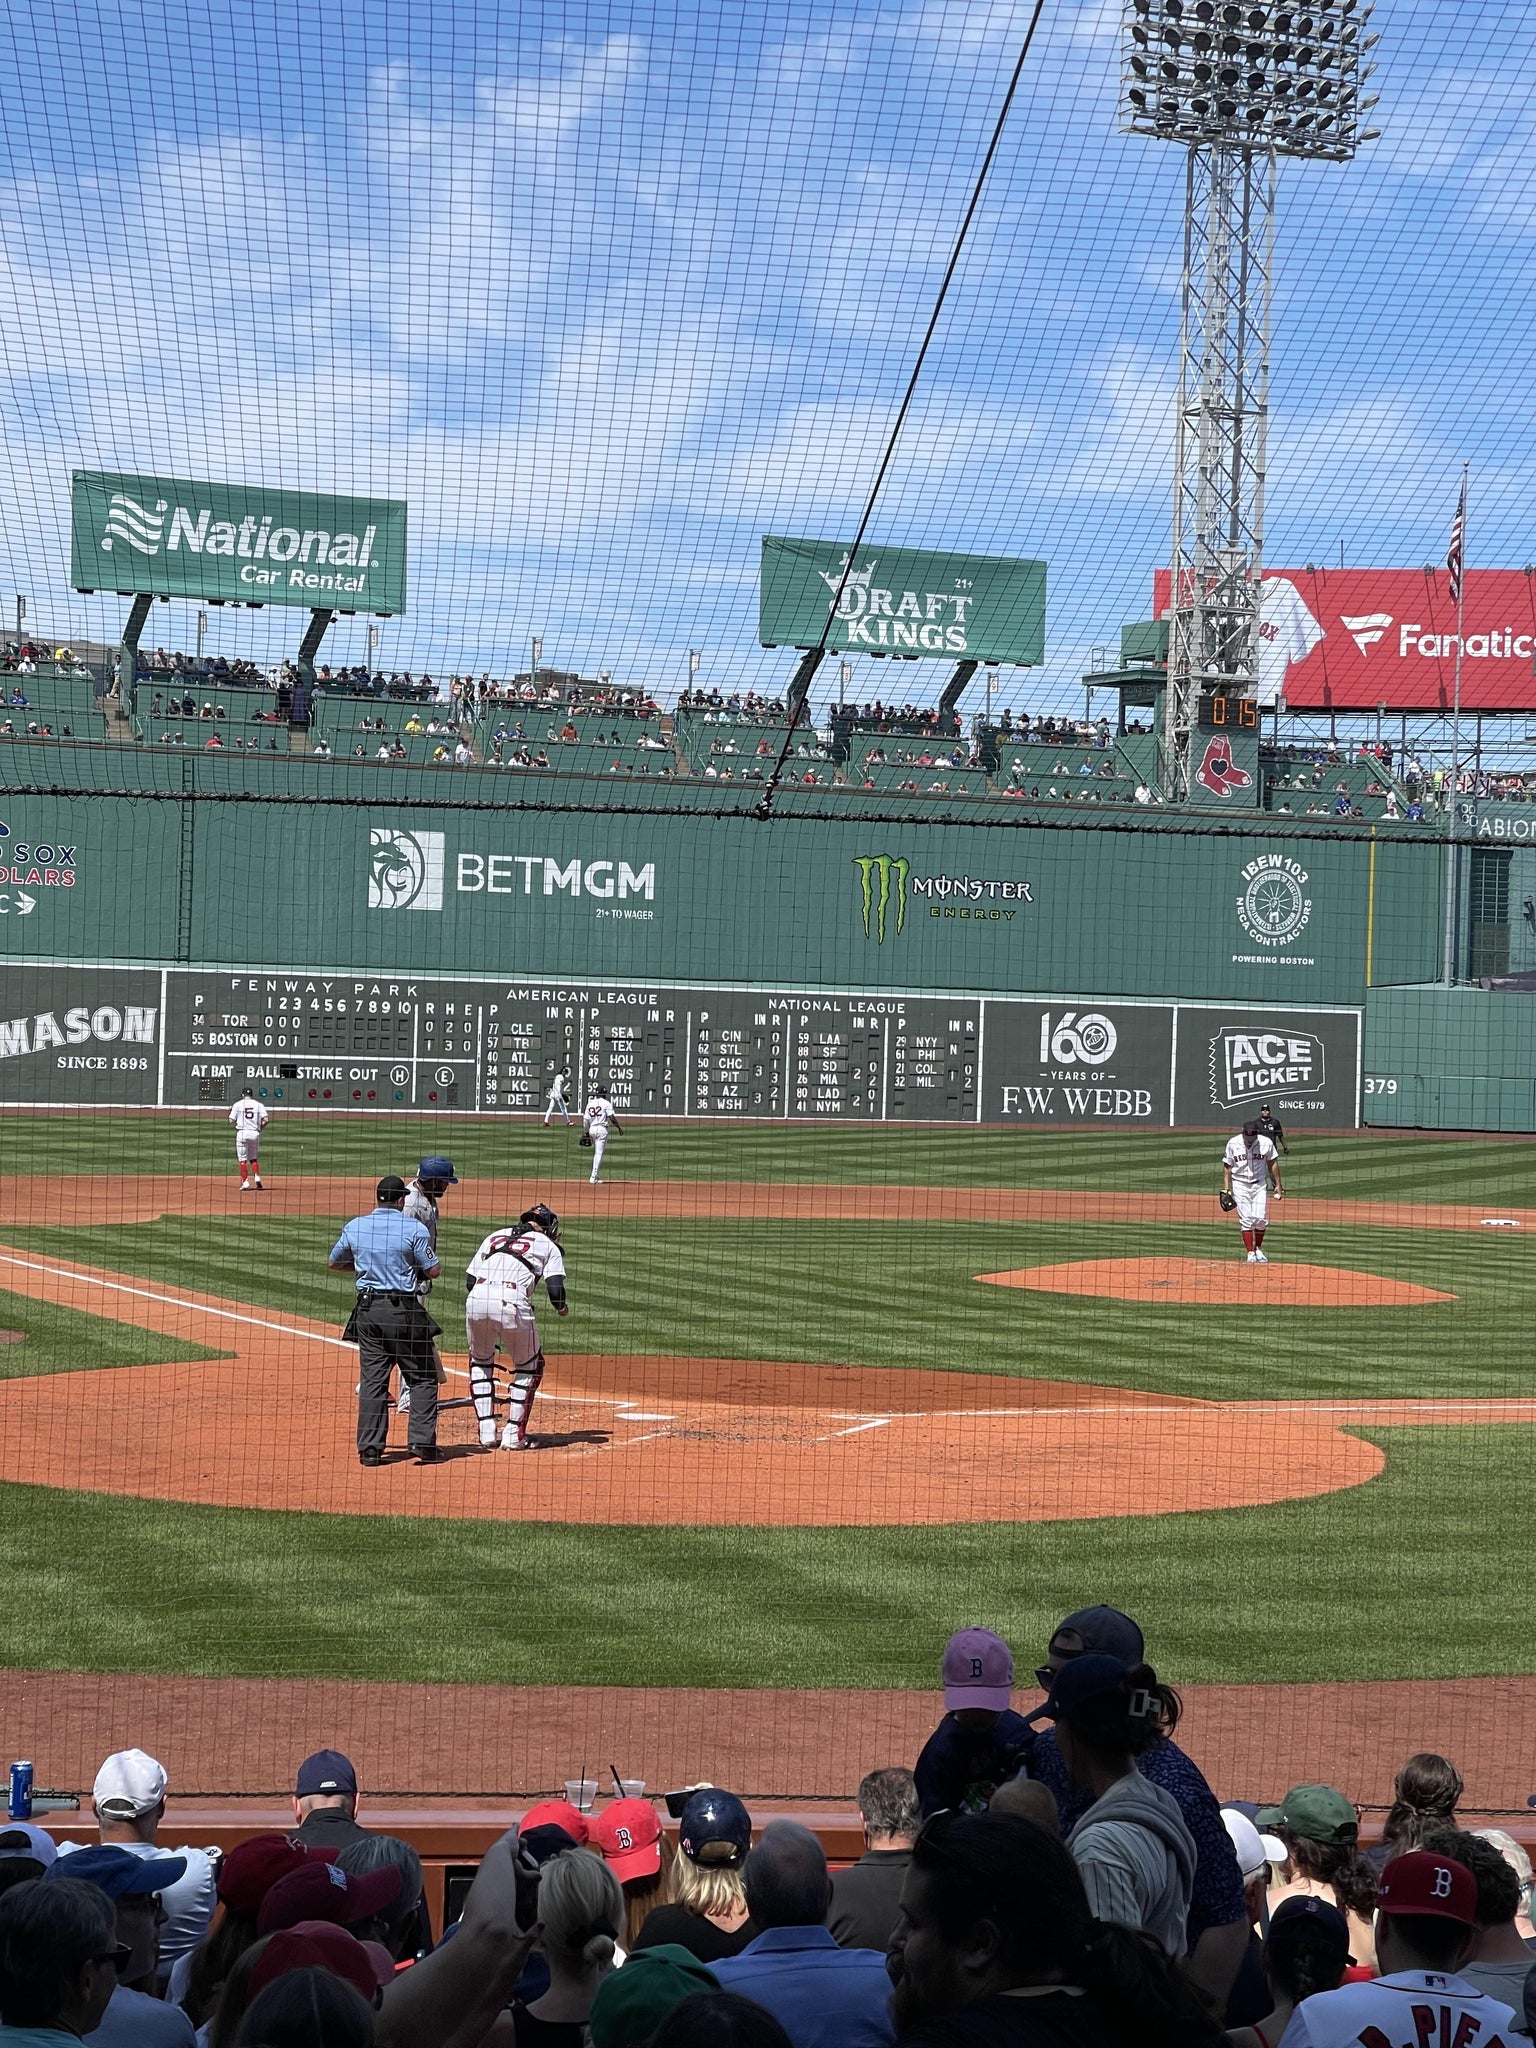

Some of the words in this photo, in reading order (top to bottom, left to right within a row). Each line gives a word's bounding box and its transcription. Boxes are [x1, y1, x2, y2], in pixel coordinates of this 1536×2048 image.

[167, 507, 376, 567] National
[241, 566, 281, 585] Car
[289, 569, 365, 592] Rental
[955, 578, 973, 589] 21+
[829, 584, 972, 622] DRAFT
[847, 615, 968, 651] KINGS
[14, 844, 77, 866] SOX
[457, 853, 655, 900] BETMGM
[912, 874, 1034, 902] MONSTER
[596, 909, 609, 918] 21+
[612, 909, 622, 919] TO
[624, 910, 653, 920] WAGER
[930, 907, 1016, 920] ENERGY
[1236, 897, 1250, 931] NECA
[1249, 899, 1312, 947] CONTRACTORS
[1232, 955, 1277, 964] POWERING
[1280, 956, 1314, 965] BOSTON
[232, 979, 333, 993] FENWAY
[354, 984, 417, 997] PARK
[506, 989, 589, 1003] AMERICAN
[598, 992, 657, 1005] LEAGUE
[195, 995, 203, 1007] P
[279, 997, 287, 1009] 2
[293, 997, 301, 1010] 3
[310, 998, 319, 1010] 4
[324, 999, 333, 1011] 5
[337, 999, 346, 1012] 6
[356, 1000, 363, 1012] 7
[369, 1001, 377, 1013] 8
[381, 1001, 390, 1013] 9
[399, 1002, 411, 1014] 10
[426, 1003, 434, 1014] R
[446, 1003, 454, 1015] H
[465, 1004, 472, 1015] E
[769, 999, 841, 1012] NATIONAL
[849, 1001, 905, 1014] LEAGUE
[490, 1005, 498, 1016] P
[547, 1007, 558, 1018] IN
[565, 1007, 573, 1018] R
[591, 1008, 599, 1019] P
[647, 1010, 659, 1021] IN
[666, 1010, 674, 1021] R
[192, 1014, 204, 1026] 34
[222, 1015, 248, 1027] TOR
[265, 1016, 273, 1027] 0
[279, 1017, 286, 1028] 0
[292, 1017, 300, 1028] 0
[426, 1021, 433, 1032] 0
[446, 1022, 453, 1033] 2
[464, 1022, 471, 1033] 0
[701, 1012, 709, 1023] P
[755, 1014, 766, 1025] IN
[773, 1015, 780, 1025] R
[801, 1015, 808, 1026] P
[853, 1017, 864, 1028] IN
[871, 1018, 878, 1029] R
[489, 1023, 499, 1034] 77
[511, 1024, 533, 1035] CLE
[898, 1019, 905, 1029] P
[949, 1020, 960, 1031] IN
[966, 1021, 973, 1031] R
[0, 1005, 157, 1059] MASON
[590, 1027, 600, 1037] 36
[612, 1027, 634, 1038] SEA
[699, 1030, 708, 1041] 41
[722, 1030, 741, 1041] CIN
[192, 1033, 204, 1045] 55
[209, 1033, 257, 1046] BOSTON
[264, 1035, 272, 1047] 0
[278, 1035, 286, 1047] 0
[445, 1040, 452, 1051] 3
[463, 1041, 471, 1052] 0
[488, 1037, 498, 1048] 57
[514, 1038, 529, 1049] TB
[799, 1033, 809, 1043] 59
[820, 1034, 840, 1044] LAA
[896, 1036, 906, 1046] 29
[916, 1037, 937, 1047] NYY
[1040, 1012, 1117, 1065] 160
[589, 1040, 599, 1050] 48
[612, 1041, 632, 1051] TEX
[698, 1044, 709, 1054] 62
[720, 1044, 741, 1055] STL
[1232, 1034, 1313, 1068] ACE
[488, 1052, 498, 1063] 40
[512, 1052, 531, 1063] ATL
[798, 1047, 808, 1056] 88
[823, 1047, 837, 1057] SF
[896, 1050, 904, 1059] 61
[918, 1050, 935, 1060] PHI
[57, 1056, 107, 1069] SINCE
[112, 1057, 147, 1070] 1898
[588, 1055, 599, 1065] 56
[610, 1055, 633, 1065] HOU
[698, 1058, 708, 1068] 50
[719, 1058, 742, 1069] CHC
[799, 1061, 807, 1070] 10
[823, 1061, 837, 1071] SD
[191, 1065, 208, 1077] AT
[211, 1065, 233, 1078] BAT
[246, 1066, 280, 1078] BALL
[296, 1067, 342, 1080] STRIKE
[350, 1068, 378, 1081] OUT
[487, 1066, 497, 1076] 34
[509, 1066, 532, 1077] BAL
[588, 1068, 598, 1079] 47
[609, 1069, 633, 1079] CWS
[896, 1063, 904, 1073] 21
[915, 1064, 937, 1074] COL
[697, 1071, 708, 1081] 35
[721, 1071, 739, 1082] PIT
[797, 1074, 807, 1084] 26
[821, 1074, 838, 1085] MIA
[895, 1077, 905, 1087] 32
[917, 1077, 935, 1087] MIL
[1051, 1071, 1086, 1081] YEARS
[1091, 1072, 1106, 1081] OF
[1233, 1066, 1313, 1092] TICKET
[486, 1080, 497, 1091] 58
[512, 1080, 528, 1091] KC
[610, 1083, 631, 1094] ATH
[697, 1085, 708, 1095] 58
[722, 1086, 738, 1096] AZ
[1364, 1078, 1398, 1095] 379
[797, 1088, 807, 1098] 80
[818, 1088, 839, 1098] LAD
[486, 1094, 496, 1104] 59
[508, 1094, 531, 1105] DET
[610, 1096, 630, 1107] MIN
[697, 1099, 708, 1109] 36
[718, 1099, 741, 1110] WSH
[1000, 1086, 1053, 1115] F.W.
[1061, 1088, 1152, 1117] WEBB
[1278, 1100, 1303, 1109] SINCE
[1305, 1101, 1325, 1110] 1979
[589, 1106, 602, 1117] 32
[797, 1101, 806, 1111] 41
[817, 1101, 840, 1112] NYM
[245, 1107, 254, 1119] 5
[969, 1659, 983, 1678] B
[616, 1828, 632, 1850] B
[1430, 1867, 1454, 1898] B
